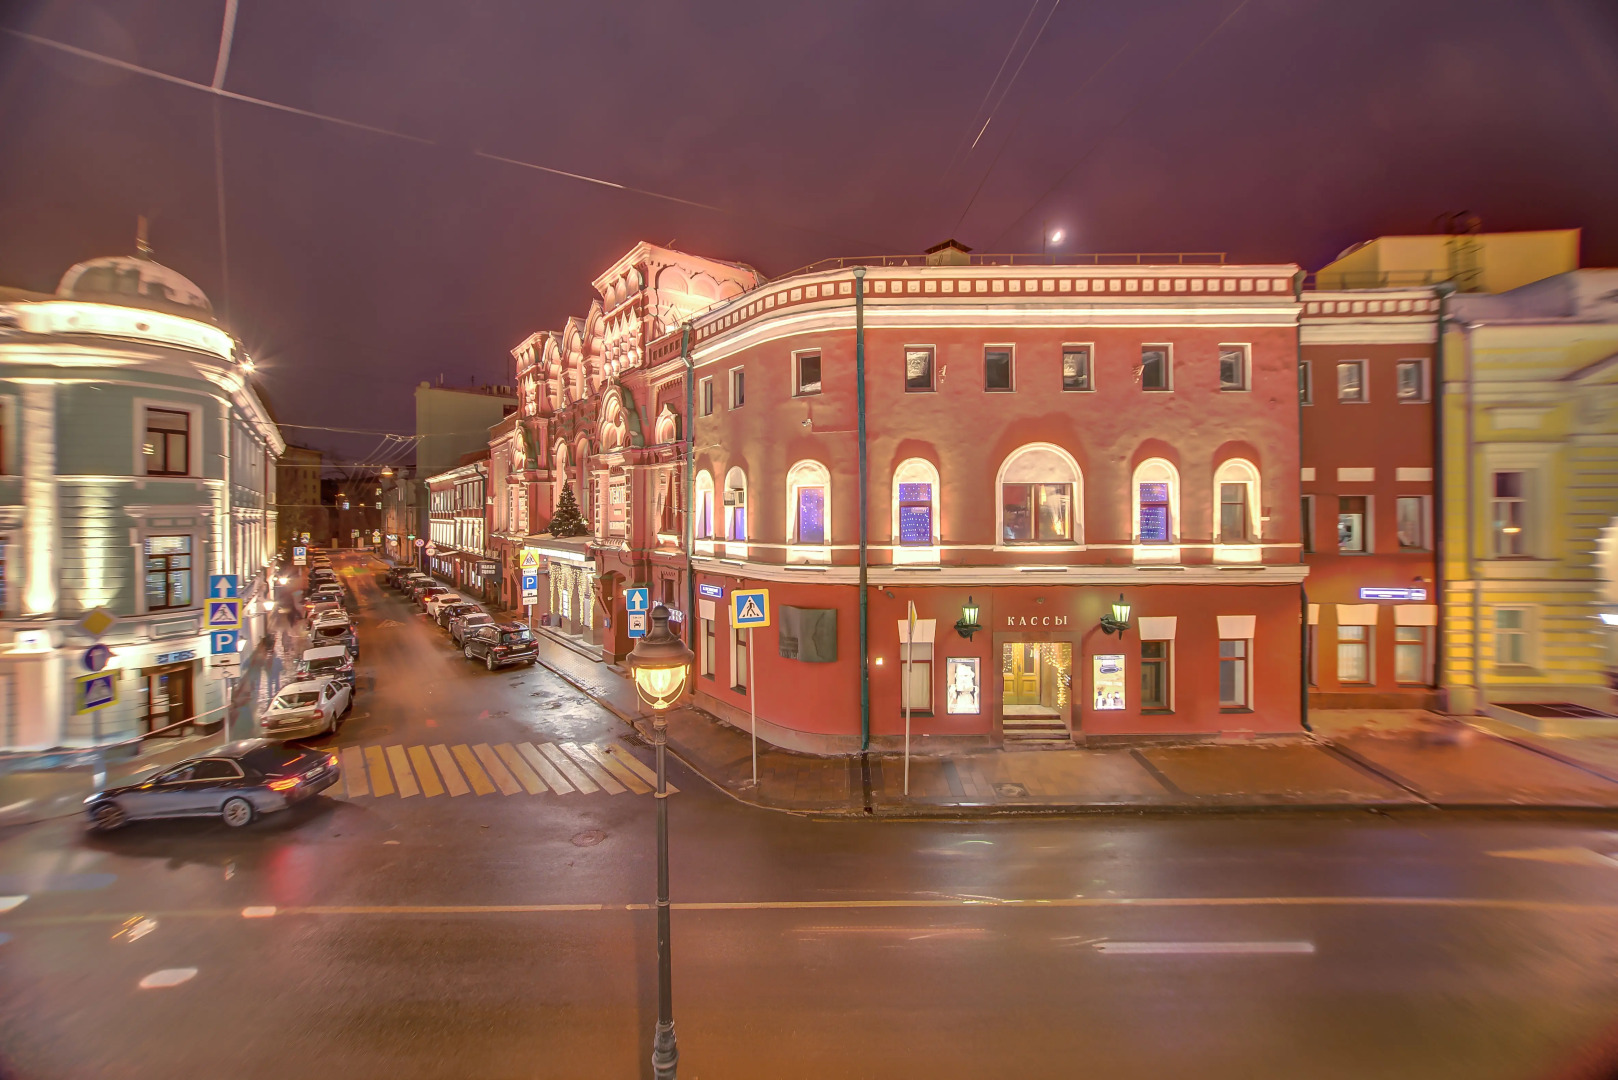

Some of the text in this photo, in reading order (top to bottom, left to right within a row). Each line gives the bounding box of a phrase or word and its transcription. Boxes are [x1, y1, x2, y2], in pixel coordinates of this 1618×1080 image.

[296, 548, 304, 556] P
[526, 577, 535, 589] P
[1007, 615, 1068, 626] КАССЫ
[216, 633, 233, 652] P
